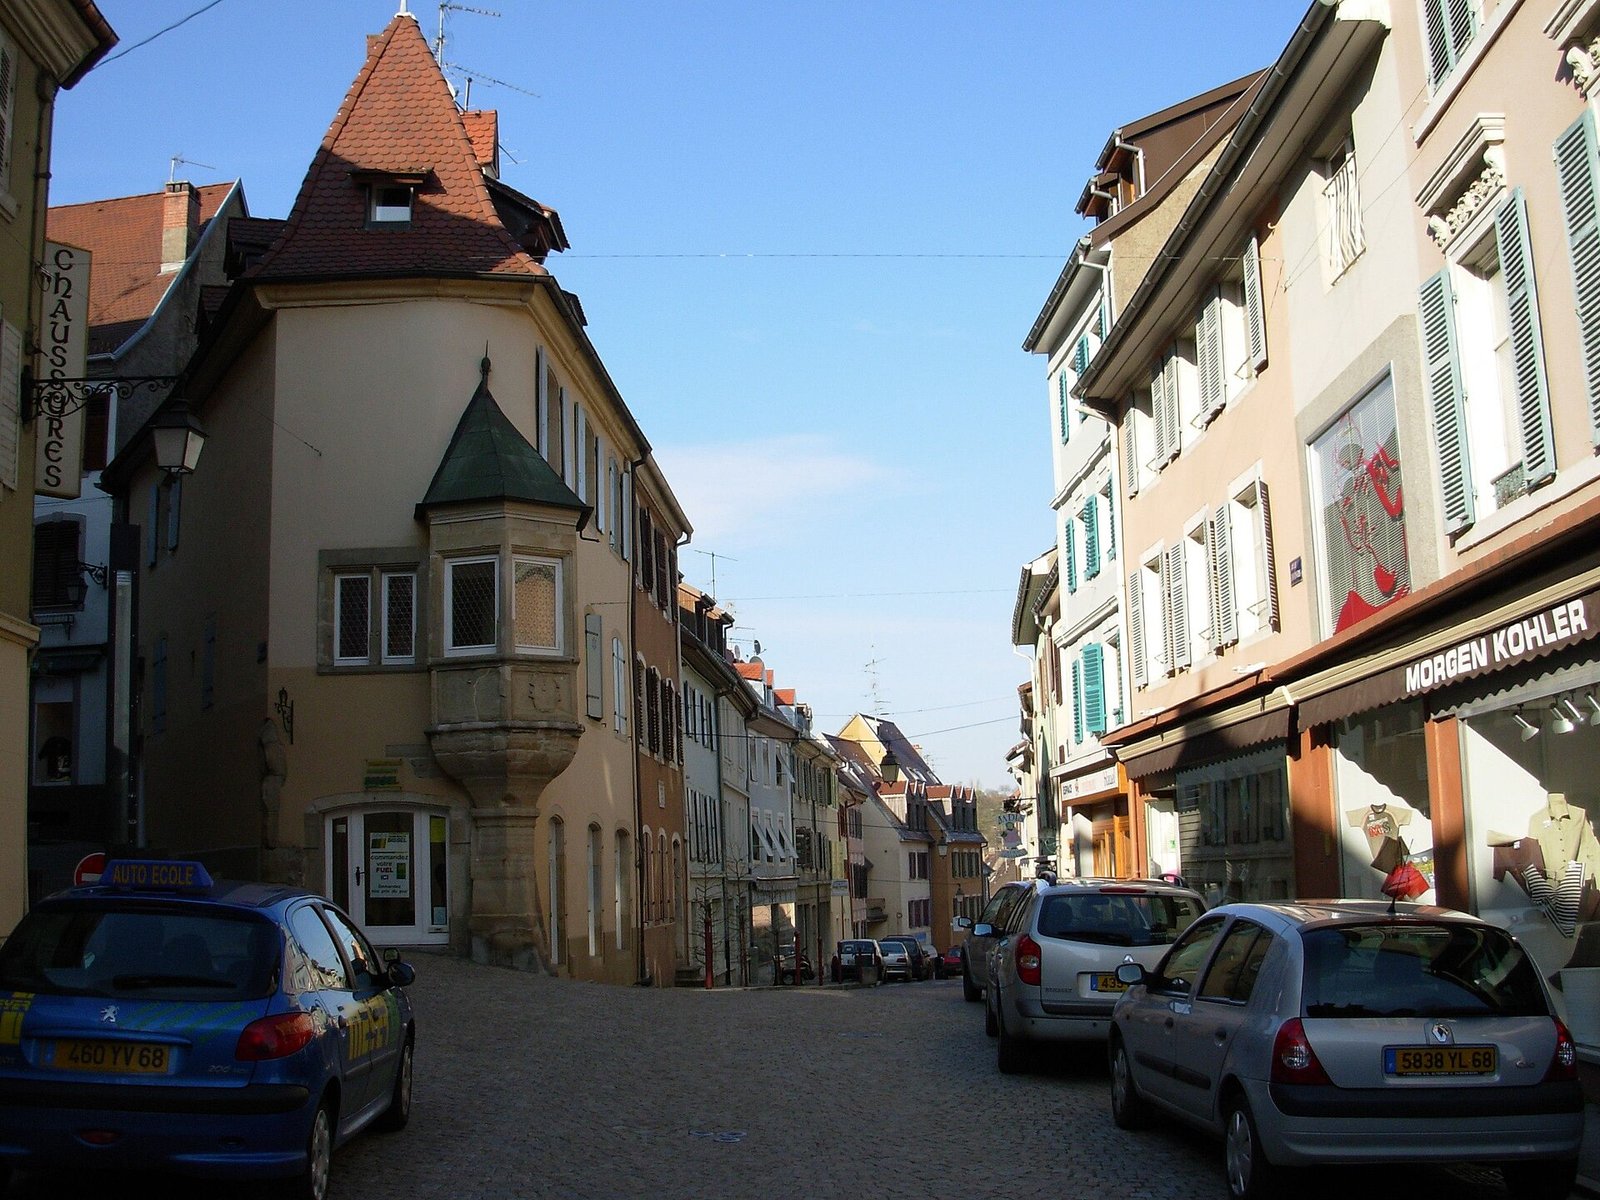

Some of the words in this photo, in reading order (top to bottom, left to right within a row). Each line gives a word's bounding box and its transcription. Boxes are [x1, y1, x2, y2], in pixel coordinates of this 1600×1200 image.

[1405, 636, 1488, 693] MORGEN
[1493, 599, 1588, 663] KOHLER
[113, 864, 146, 885] AUTO
[151, 865, 194, 887] ECOLE
[69, 1044, 106, 1065] 460
[112, 1045, 136, 1066] YV
[138, 1046, 165, 1068] 68
[1402, 1051, 1444, 1069] 5838
[1447, 1051, 1467, 1068] YL
[1471, 1051, 1493, 1069] 68
